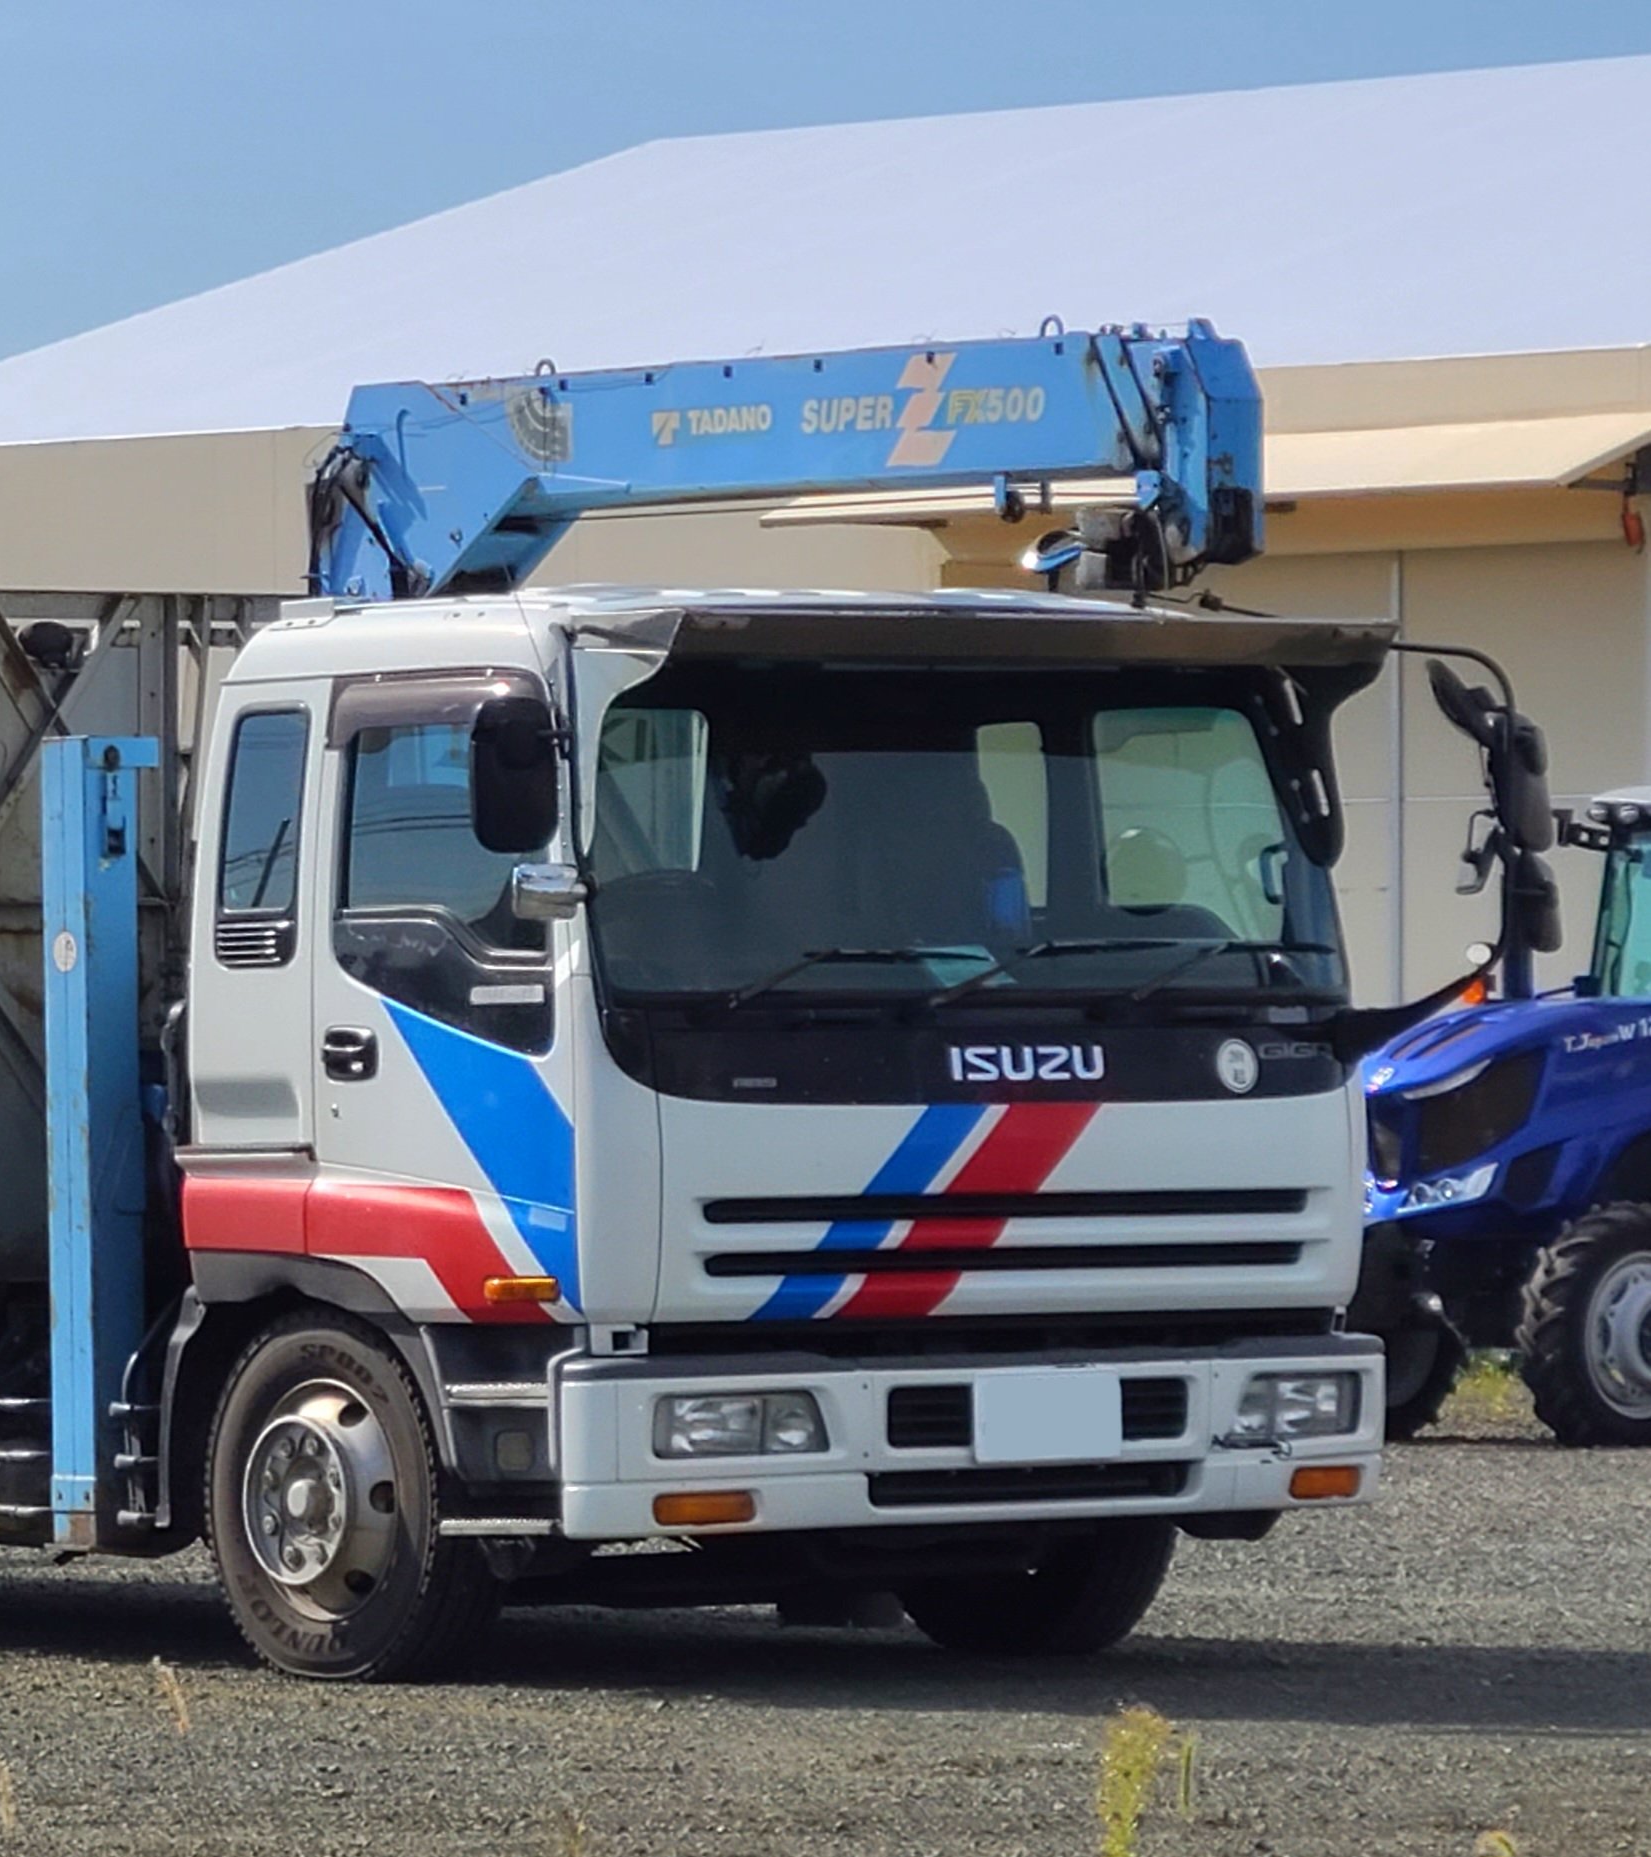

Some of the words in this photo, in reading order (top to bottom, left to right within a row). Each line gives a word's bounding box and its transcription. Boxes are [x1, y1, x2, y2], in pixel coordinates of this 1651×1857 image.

[687, 403, 772, 436] TADANO
[801, 395, 894, 434] SUPER
[947, 386, 1046, 425] FX500
[950, 1045, 1105, 1082] ISUZU
